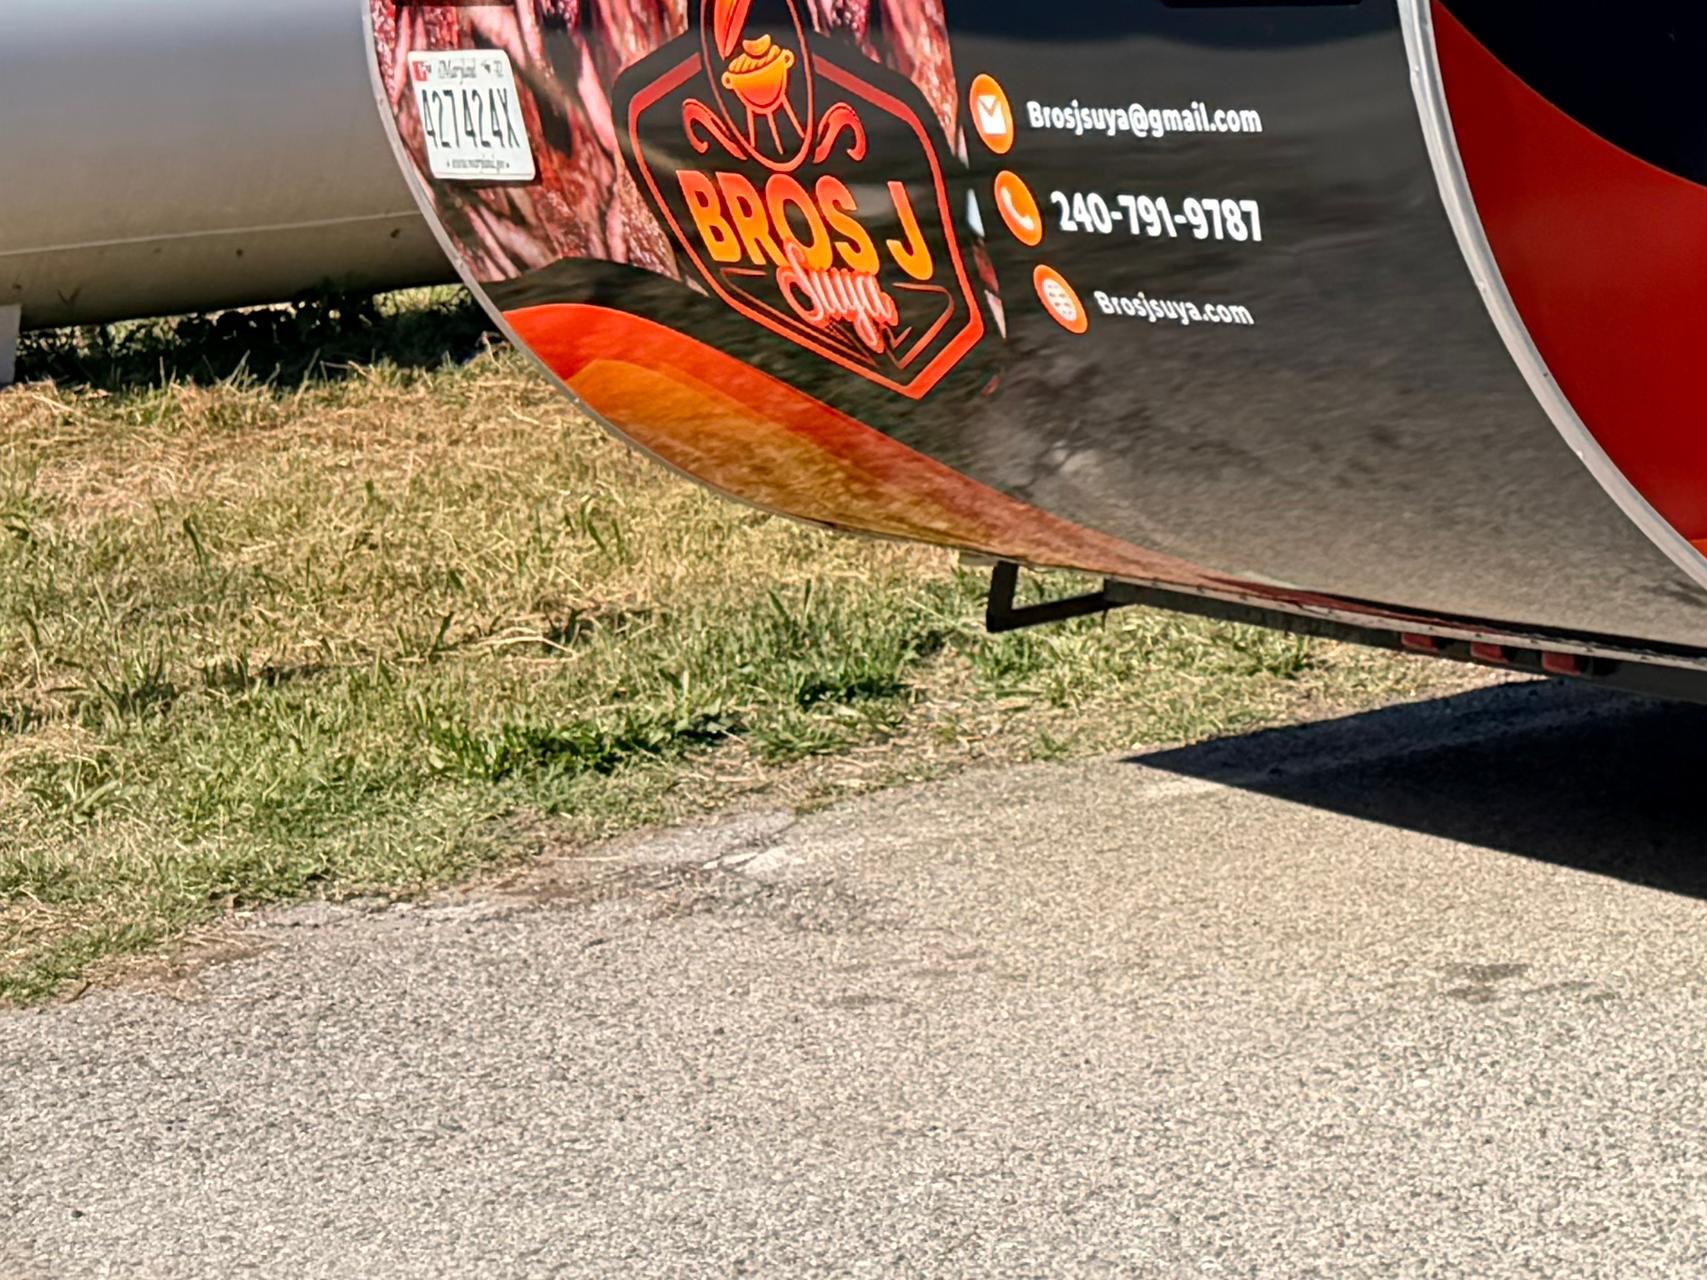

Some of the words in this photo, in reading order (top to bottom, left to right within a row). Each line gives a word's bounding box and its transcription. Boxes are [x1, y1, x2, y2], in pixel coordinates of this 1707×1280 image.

[421, 87, 521, 149] 427424X
[1026, 99, 1263, 138] Brosjsuya@gmail.com
[675, 170, 880, 276] BROS
[886, 181, 935, 281] J
[1050, 190, 1262, 242] 240-791-9787
[776, 241, 899, 354] Suya
[1093, 290, 1255, 326] Brosjsuya.com
